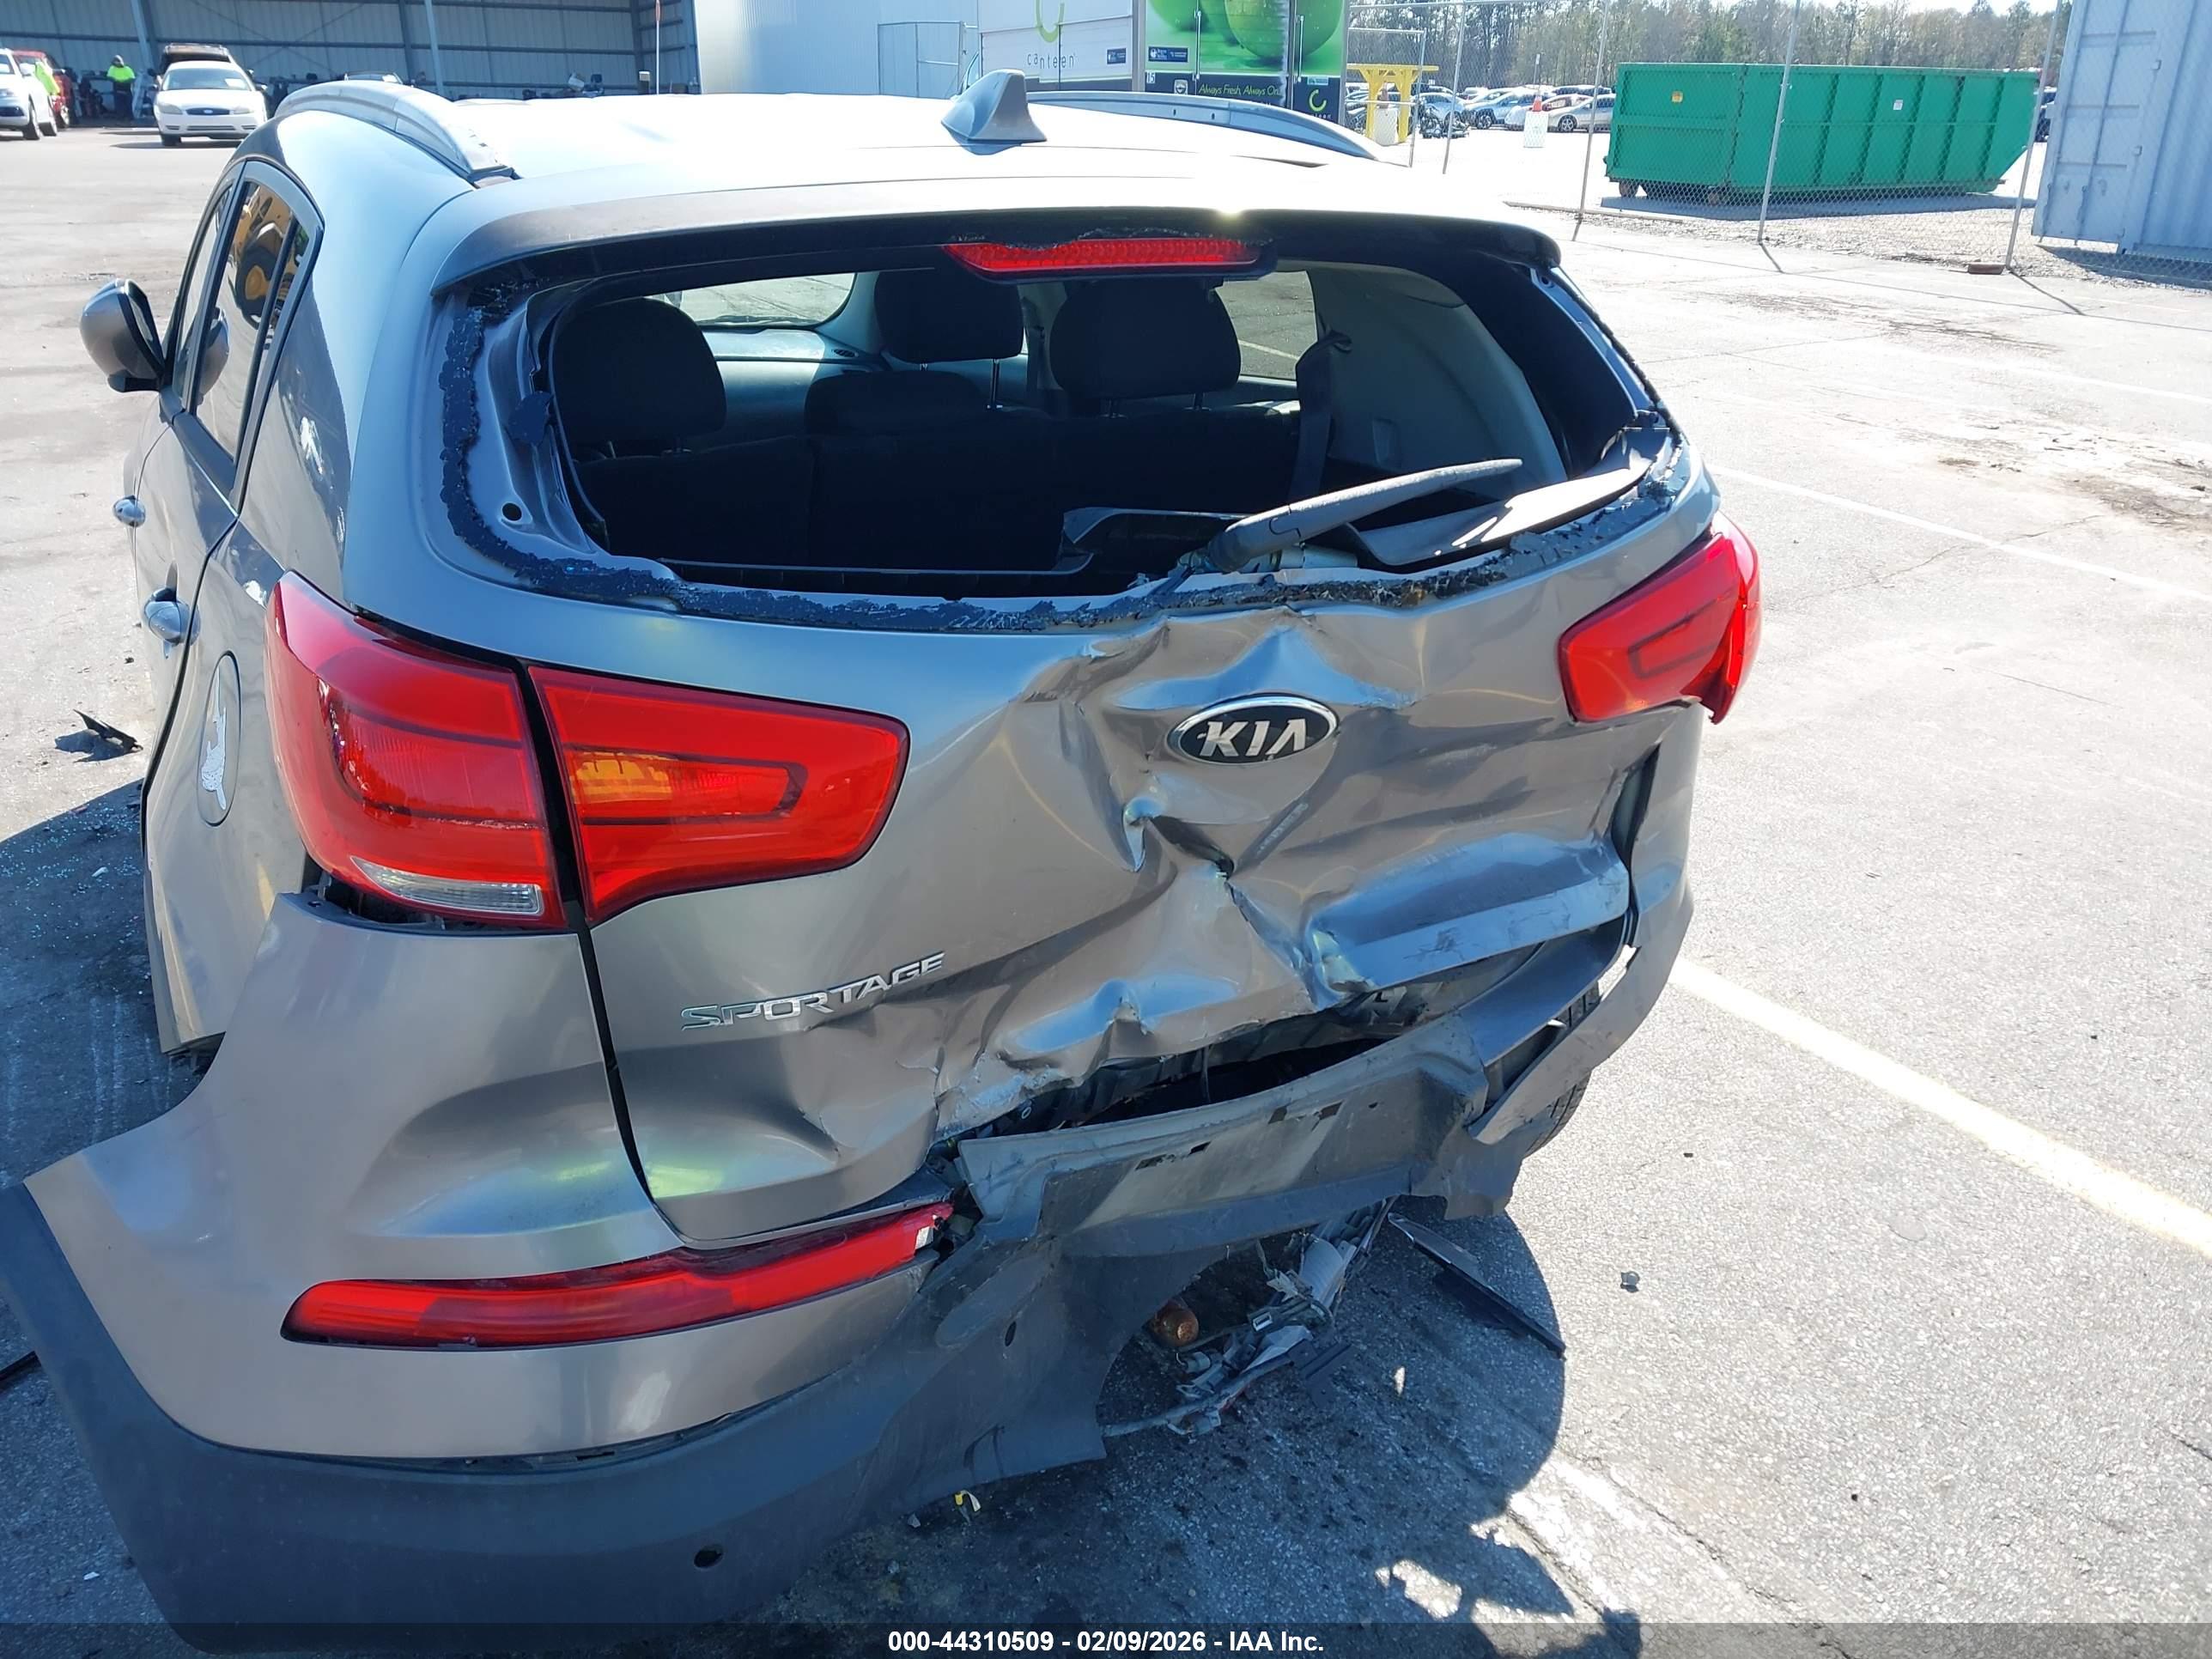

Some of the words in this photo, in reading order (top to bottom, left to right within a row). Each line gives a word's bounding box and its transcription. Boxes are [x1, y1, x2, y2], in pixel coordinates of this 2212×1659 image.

[1027, 53, 1074, 69] canteen
[1199, 83, 1222, 95] Always
[1243, 85, 1266, 96] Always
[1197, 718, 1307, 757] KIA
[681, 951, 945, 1031] SPORTAGE
